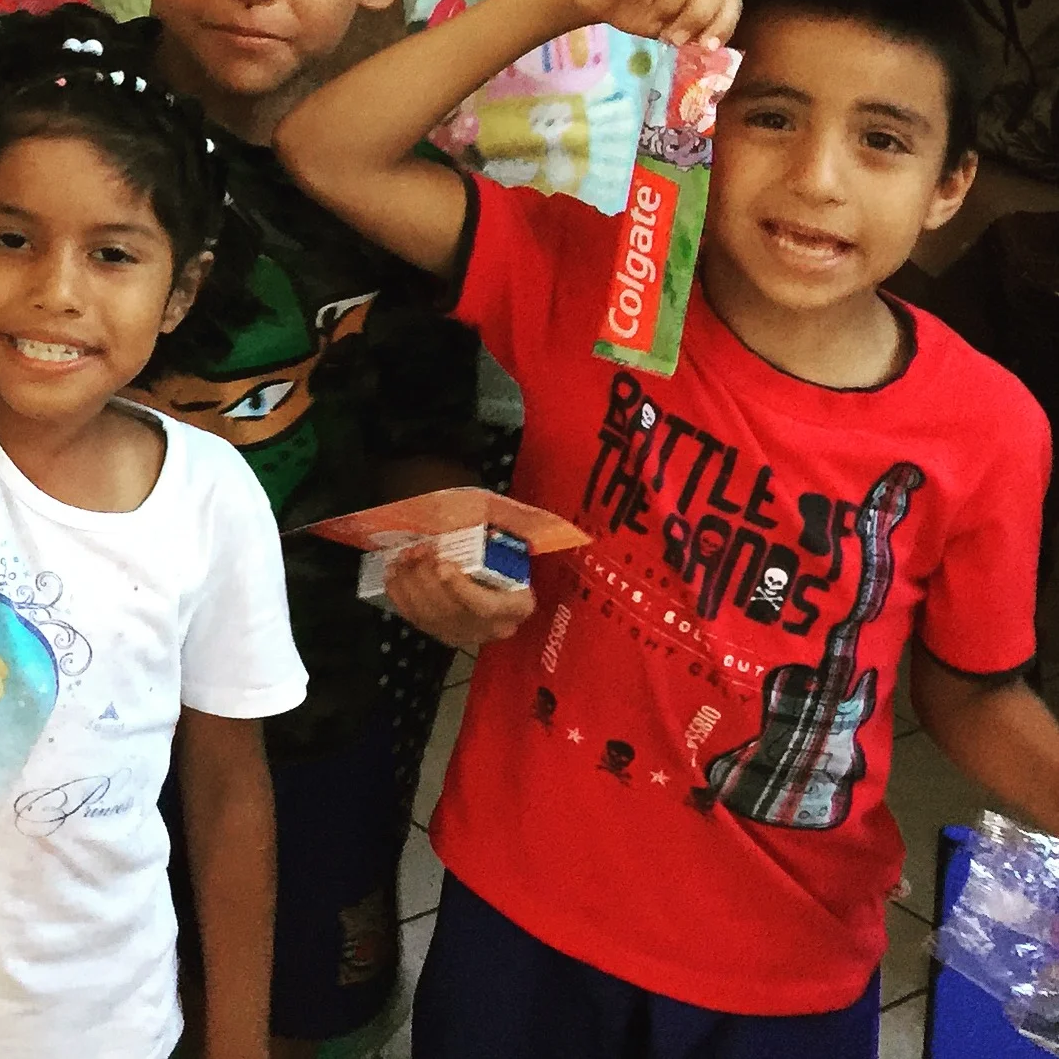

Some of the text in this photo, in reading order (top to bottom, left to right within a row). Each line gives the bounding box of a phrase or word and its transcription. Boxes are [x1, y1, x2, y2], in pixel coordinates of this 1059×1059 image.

[608, 185, 661, 338] Colgate
[603, 371, 779, 530] BATTLE
[582, 429, 649, 534] THE
[662, 512, 831, 636] BANDS
